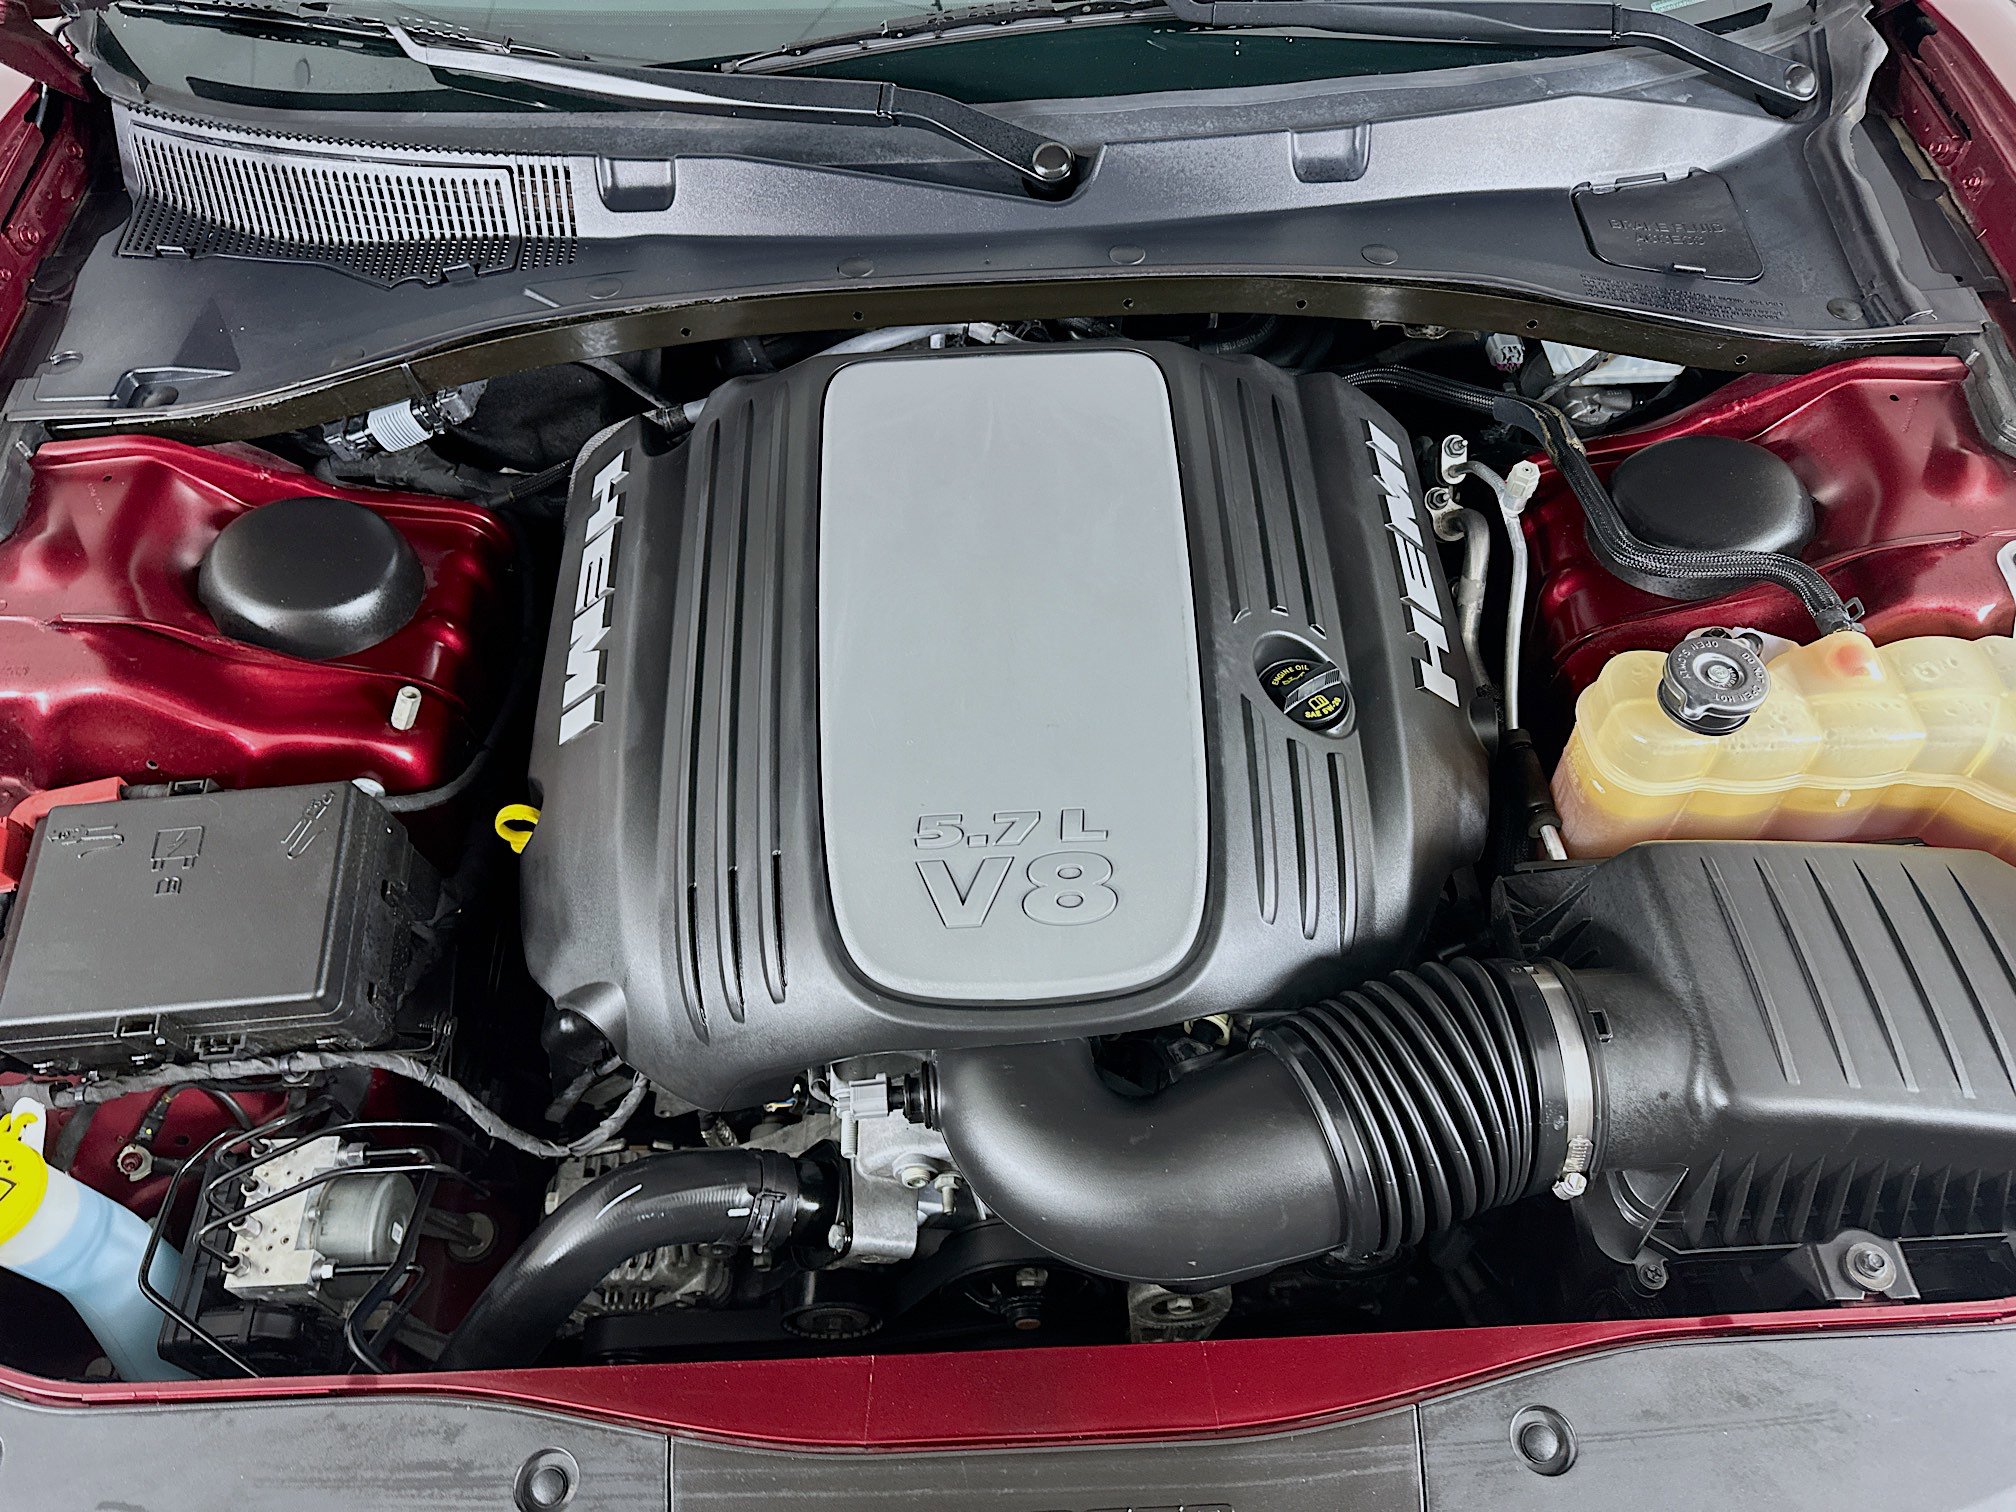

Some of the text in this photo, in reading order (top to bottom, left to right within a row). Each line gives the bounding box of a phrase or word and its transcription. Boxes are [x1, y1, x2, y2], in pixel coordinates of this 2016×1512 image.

[1608, 218, 1727, 234] BRAKE FLUID
[1634, 232, 1706, 246] ACCESS
[1361, 419, 1460, 708] HEMI
[558, 450, 629, 746] HEMI
[1678, 641, 1718, 679] OPEN SLOWLY
[1742, 653, 1755, 664] DO
[1272, 666, 1294, 685] ENGINE
[1715, 693, 1736, 702] HOT
[1304, 710, 1322, 718] SAE
[915, 807, 1109, 849] 5.7 L
[914, 850, 1119, 929] V8
